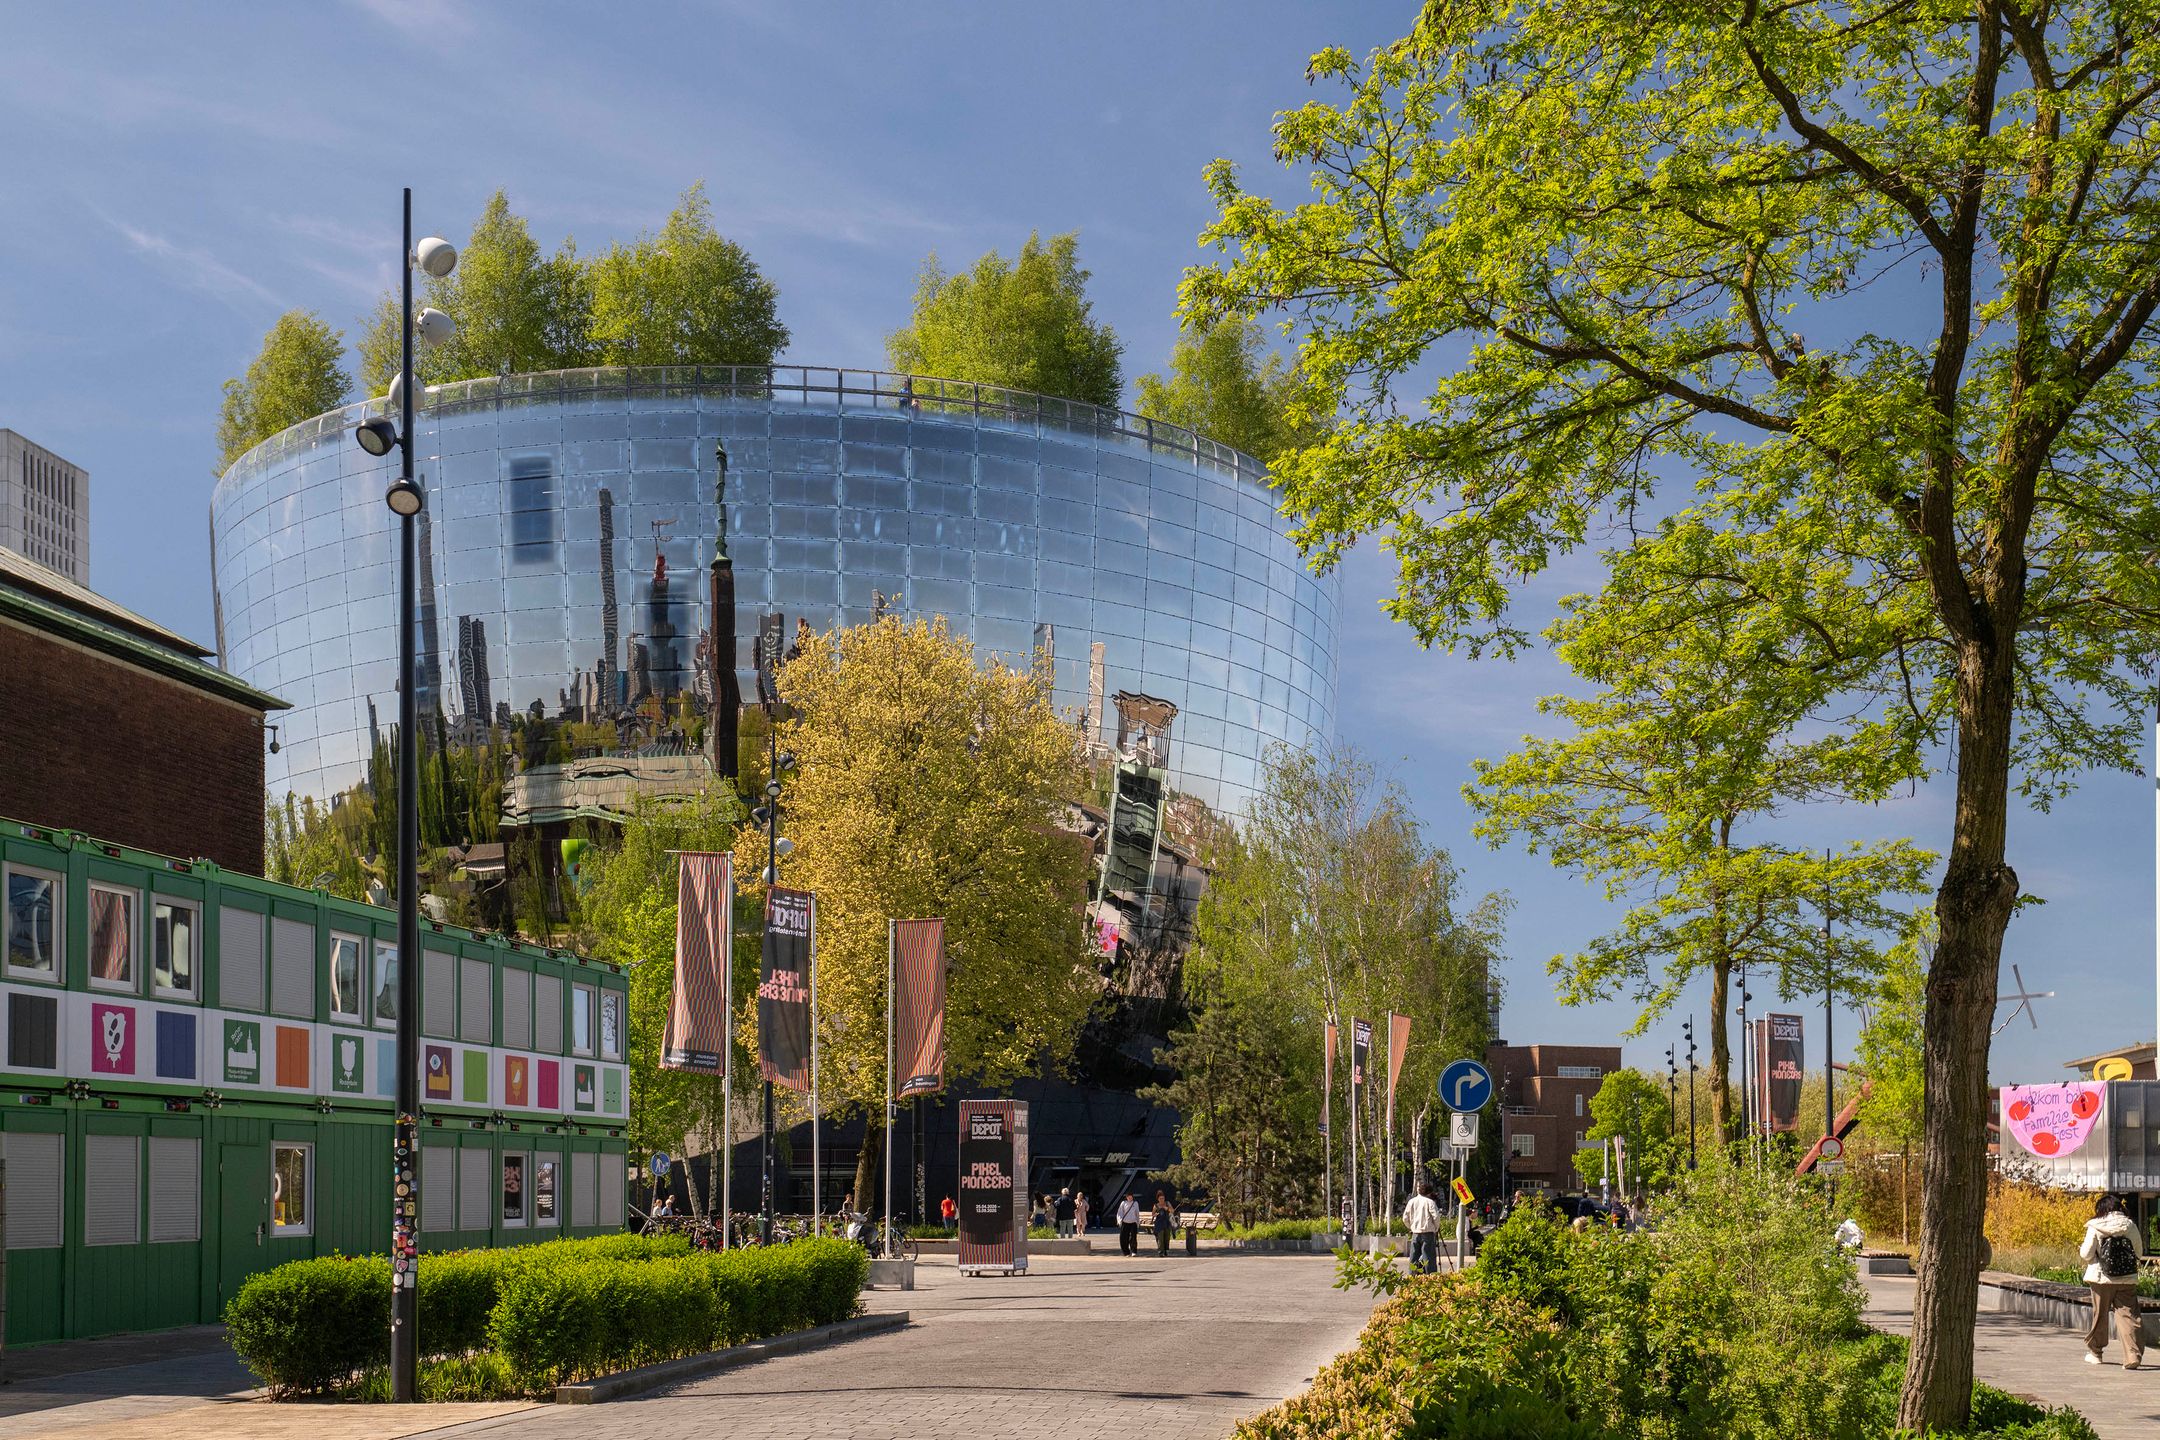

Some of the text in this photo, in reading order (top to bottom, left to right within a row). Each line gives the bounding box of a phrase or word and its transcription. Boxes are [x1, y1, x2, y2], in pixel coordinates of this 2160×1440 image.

[1773, 1025, 1800, 1037] DEPOT
[1771, 1070, 1803, 1080] PIONEERS
[971, 1123, 1003, 1135] DEPOT
[2052, 1126, 2081, 1141] Fest
[1105, 1152, 1131, 1163] DEPOT
[961, 1176, 1012, 1189] PIONEERS
[2112, 1171, 2160, 1188] Nieu
